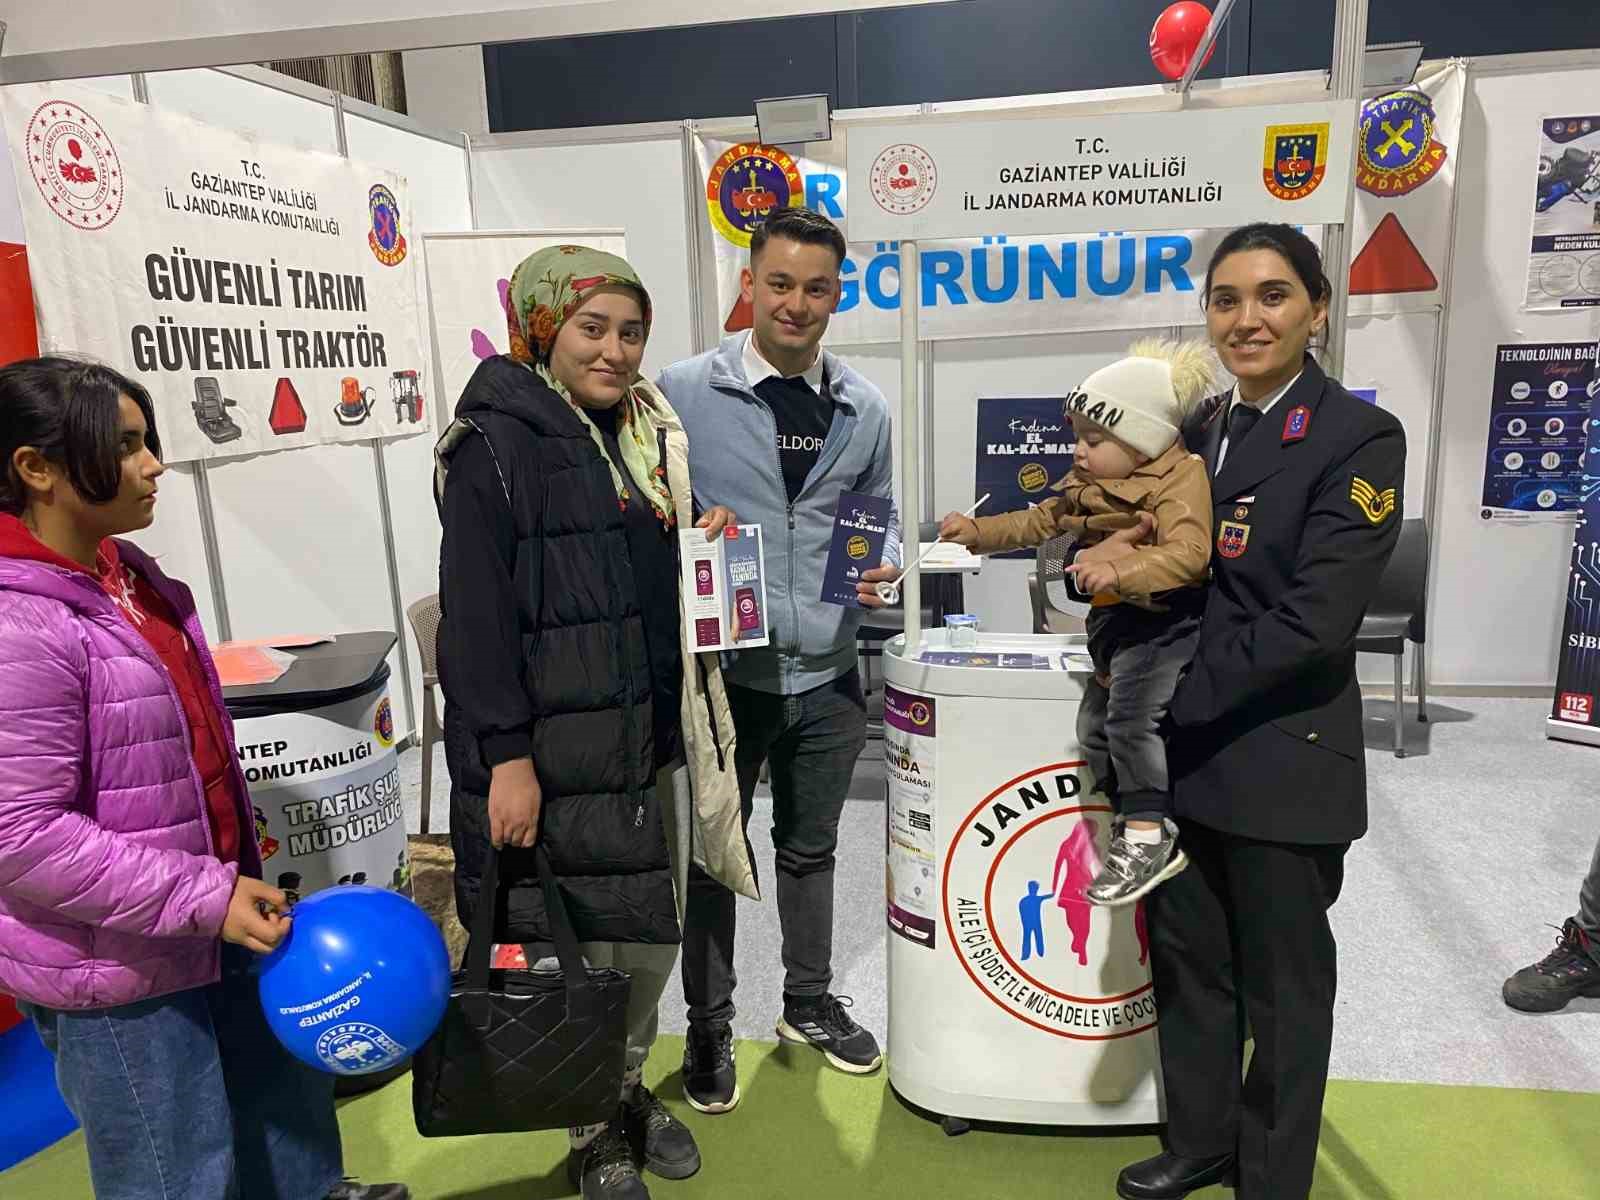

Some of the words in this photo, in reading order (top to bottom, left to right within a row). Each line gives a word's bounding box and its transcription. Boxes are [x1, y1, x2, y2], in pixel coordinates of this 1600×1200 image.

[1075, 138, 1110, 155] T.C.
[240, 159, 265, 180] T.C.
[711, 145, 798, 189] JANDARMA
[1000, 163, 1103, 184] GAZİANTEP
[1108, 158, 1186, 180] VALİLİĞİ
[191, 171, 266, 202] GAZİANTEP
[269, 186, 317, 212] VALİLİĞİ
[964, 190, 980, 211] İL
[985, 189, 1087, 210] JANDARMA
[1092, 182, 1222, 207] KOMUTANLIĞI
[1265, 174, 1322, 199] JANDARMA
[165, 186, 180, 211] İL
[183, 196, 260, 225] JANDARMA
[263, 207, 340, 237] KOMUTANLIĞI
[1554, 241, 1582, 250] NEDEN
[145, 246, 282, 307] GÜVENLİ
[288, 269, 368, 312] TARIM
[837, 231, 1194, 313] GÖRÜNÜR
[131, 316, 271, 372] GÜVENLİ
[276, 324, 387, 368] TRAKTÖR
[1500, 346, 1572, 362] TEKNOLOJİNİN
[1027, 433, 1043, 443] EL
[1565, 695, 1587, 711] 112
[245, 742, 372, 783] OMUTANLIĞI
[284, 784, 371, 826] TRAFİK
[973, 773, 1082, 848] JAND
[974, 946, 1027, 1004] ŞİDDETLE
[1024, 991, 1101, 1028] MÜCADELE
[1103, 1008, 1121, 1027] VE
[299, 995, 361, 1028] GAZİANTEP
